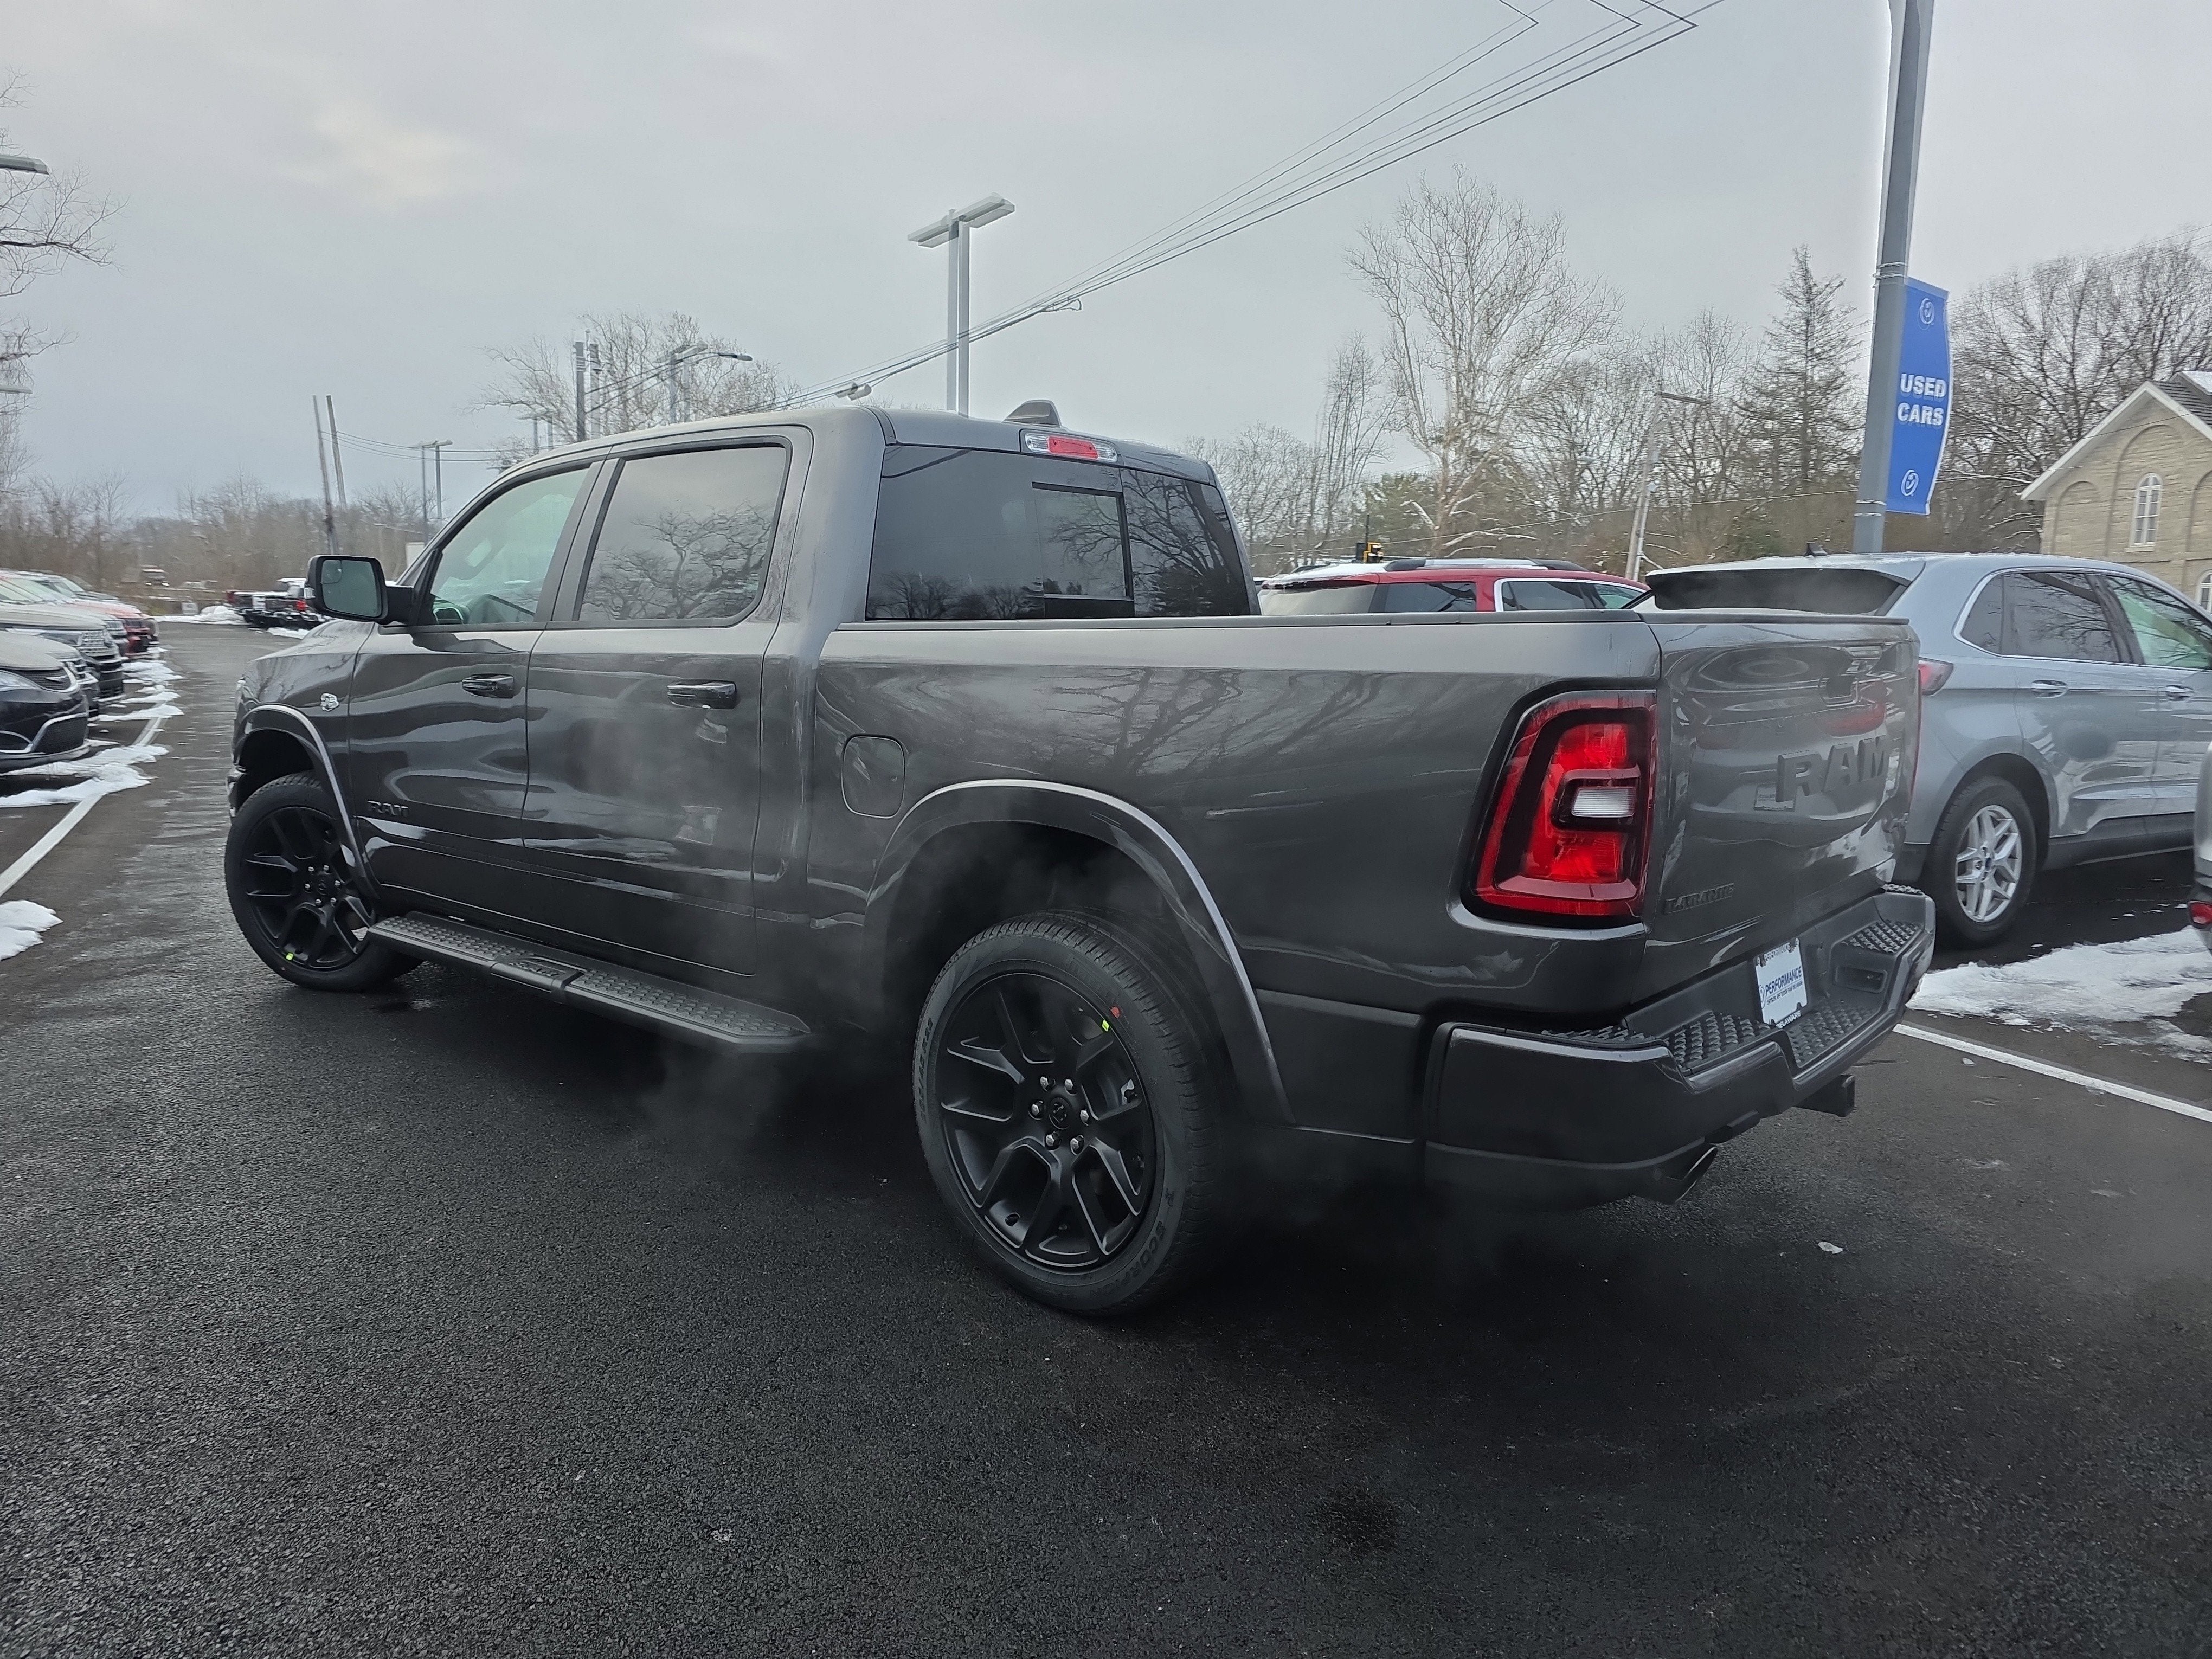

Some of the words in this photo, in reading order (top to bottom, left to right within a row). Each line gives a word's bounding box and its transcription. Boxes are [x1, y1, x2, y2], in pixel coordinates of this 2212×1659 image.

[1900, 374, 1947, 397] USED
[1898, 402, 1944, 426] CARS
[1775, 734, 1889, 802] RAM
[1765, 966, 1802, 996] PERFORMANCE
[1776, 1009, 1802, 1030] DELAWARE
